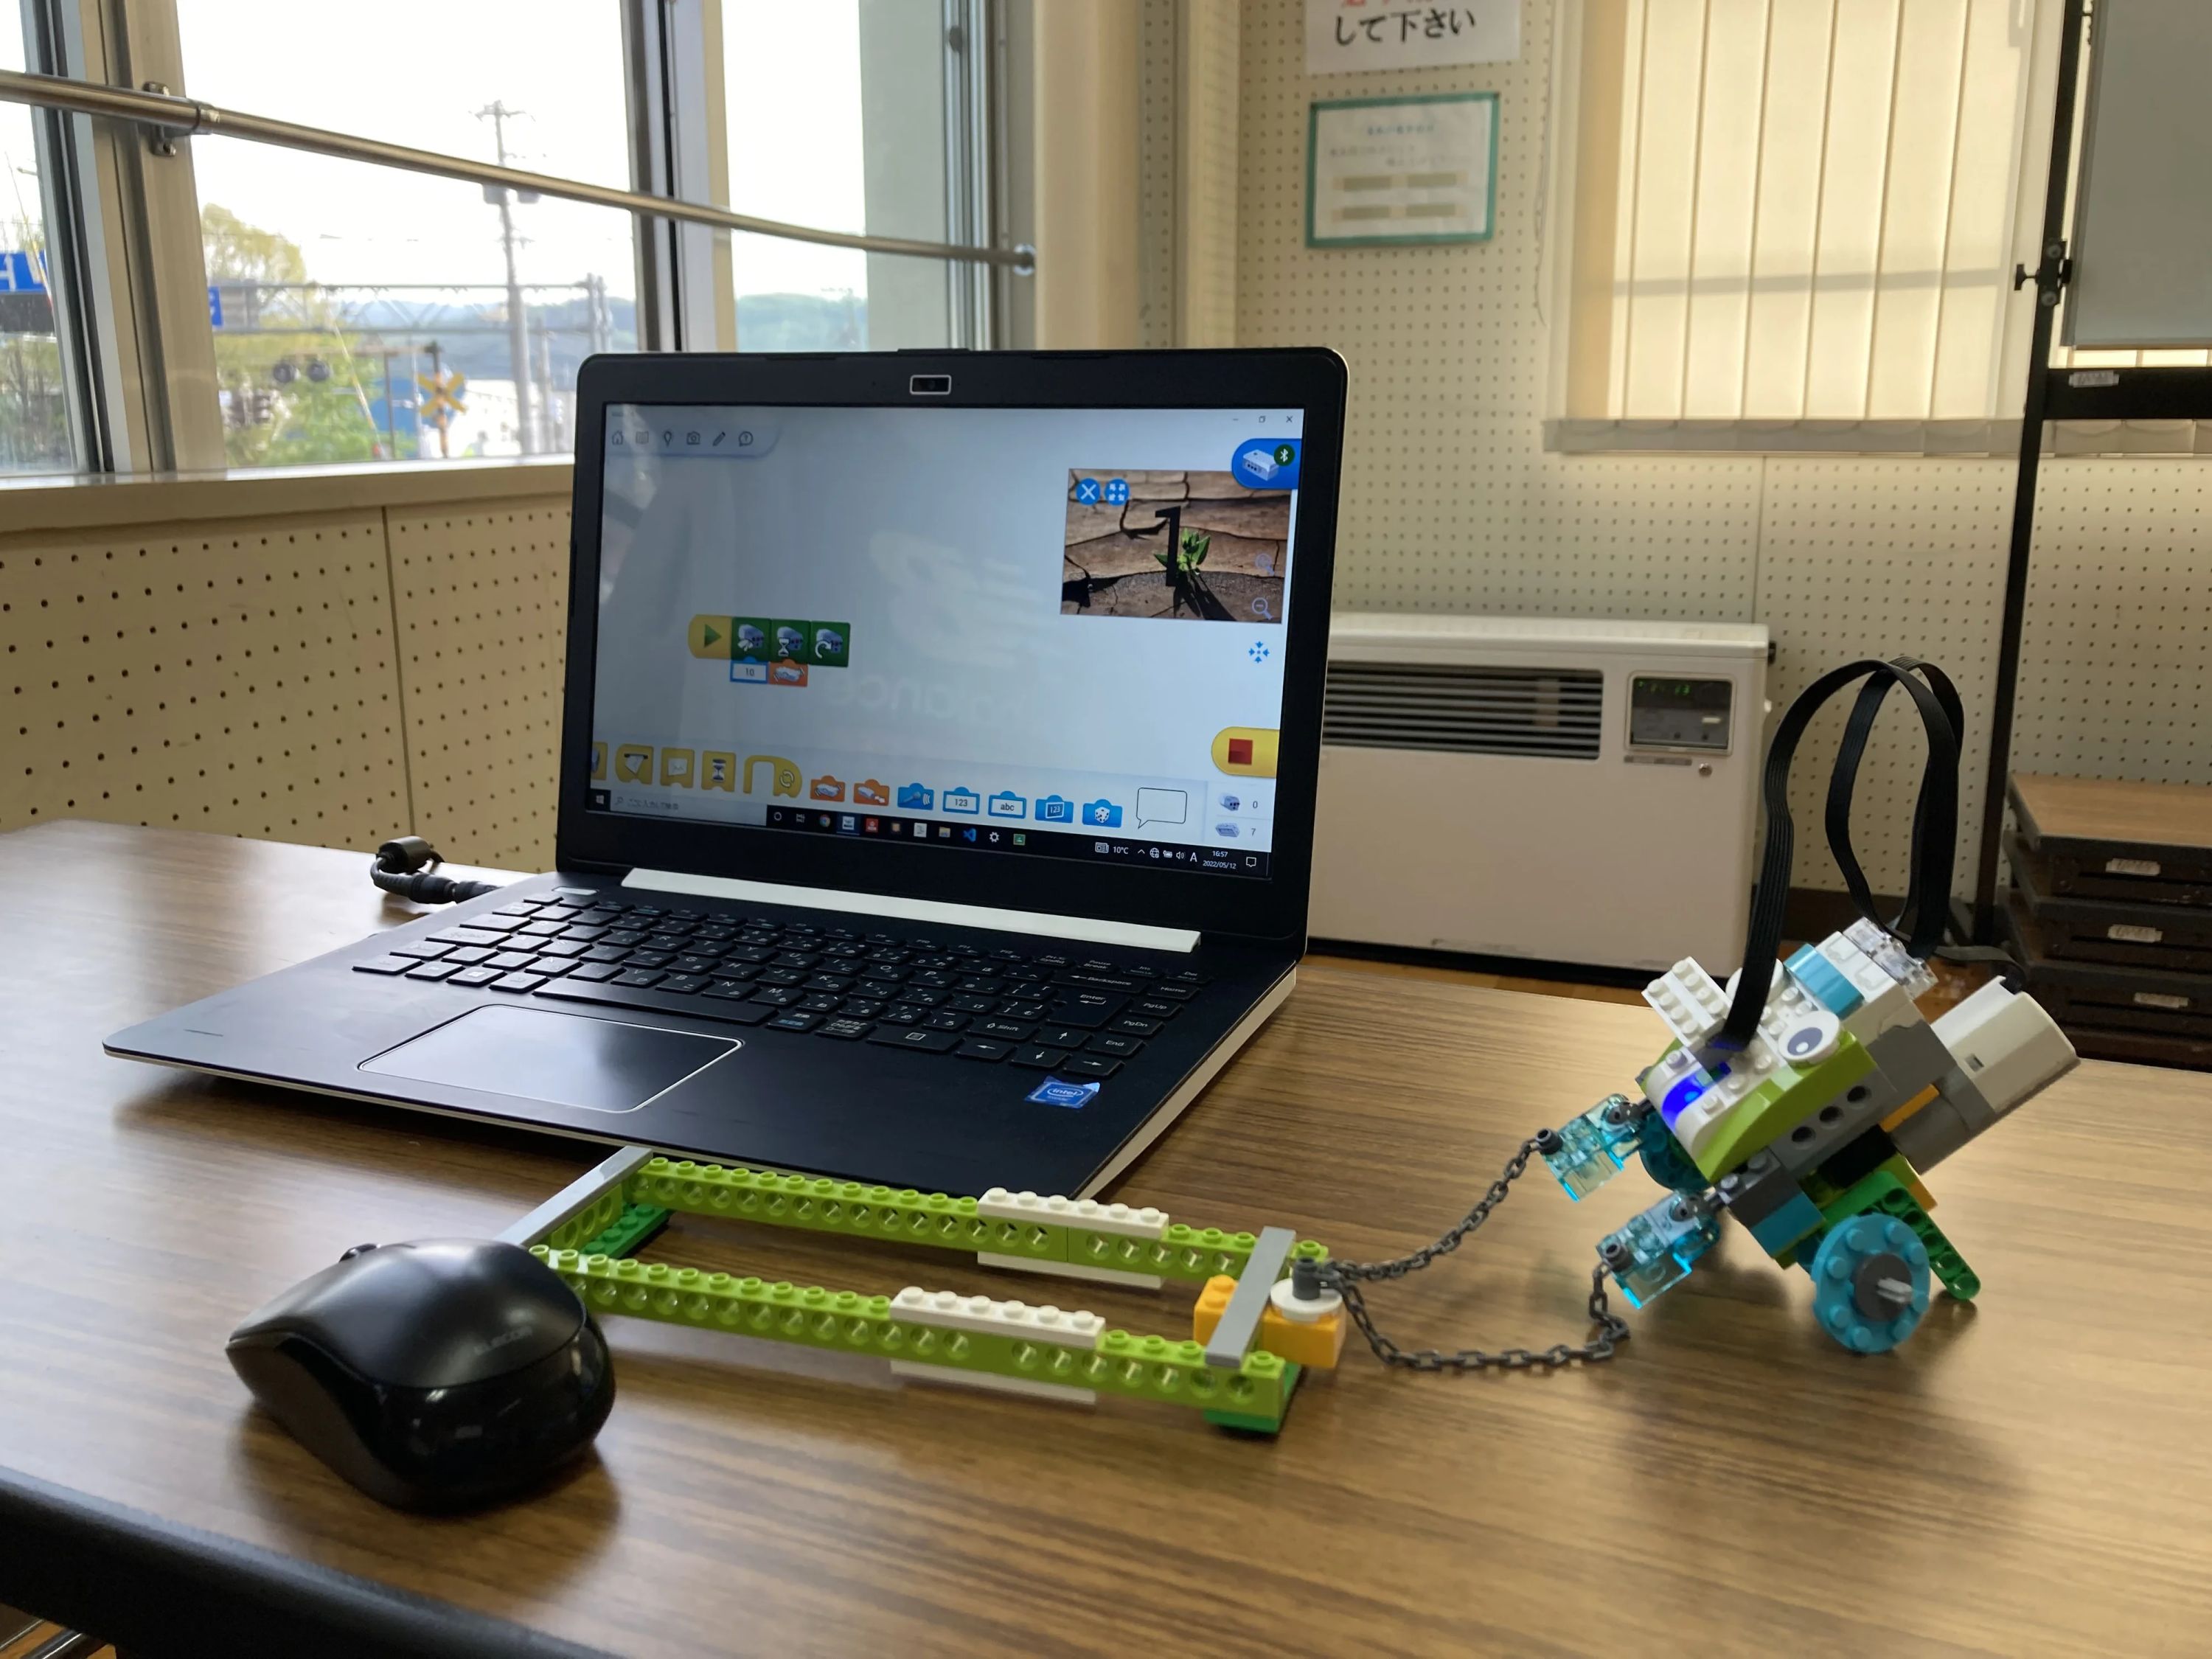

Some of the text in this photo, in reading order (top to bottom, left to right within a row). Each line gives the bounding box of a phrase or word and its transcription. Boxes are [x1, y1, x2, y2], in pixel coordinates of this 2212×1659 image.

[1335, 7, 1477, 46] して下さい
[745, 667, 755, 677] 10
[954, 799, 968, 807] 123
[1000, 803, 1015, 812] abc
[1252, 801, 1258, 809] 0
[1049, 806, 1061, 814] 123
[1251, 827, 1256, 837] 7
[1189, 852, 1197, 863] A
[1202, 860, 1237, 869] 2022/05/12
[1087, 976, 1133, 987] Backspace
[1143, 1003, 1167, 1011] PgUp
[996, 1024, 1019, 1032] Shift
[1123, 1020, 1148, 1028] PgDn
